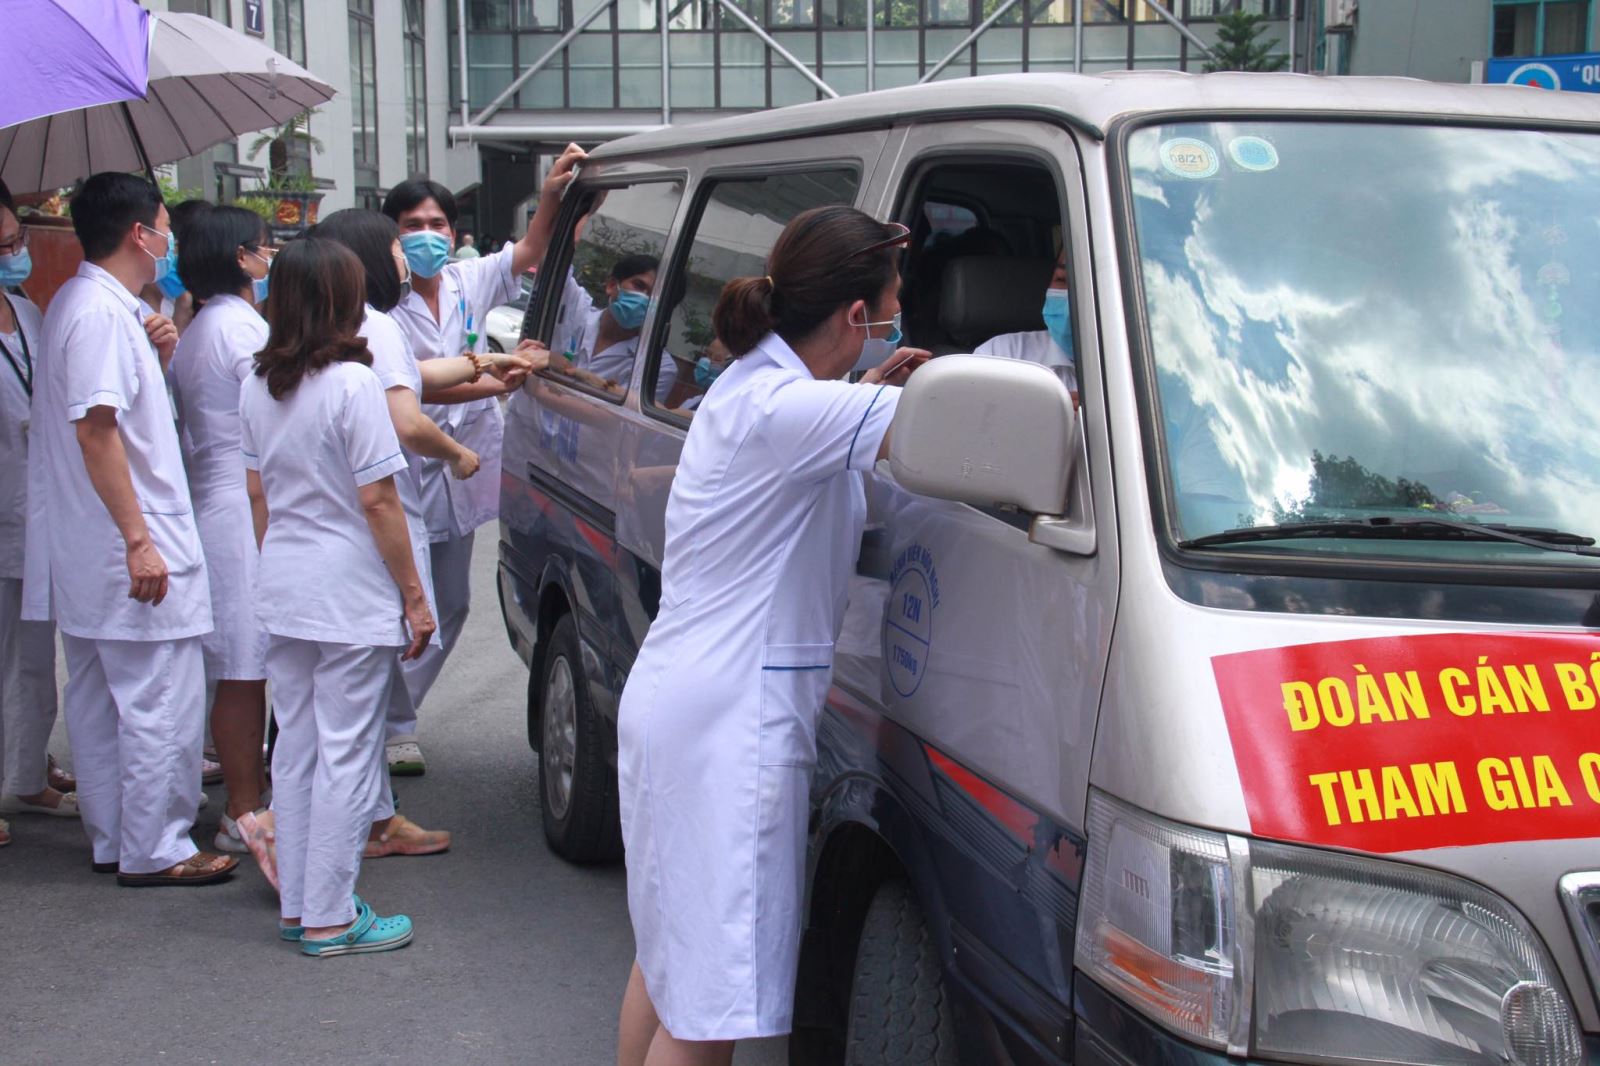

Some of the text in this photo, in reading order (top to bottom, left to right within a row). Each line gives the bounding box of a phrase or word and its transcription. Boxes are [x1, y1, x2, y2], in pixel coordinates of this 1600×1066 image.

[249, 4, 258, 29] 7
[1280, 663, 1431, 732] ĐOÀN
[1438, 655, 1551, 718] CÁN
[1309, 760, 1468, 827] THAM
[1477, 754, 1574, 811] GIA
